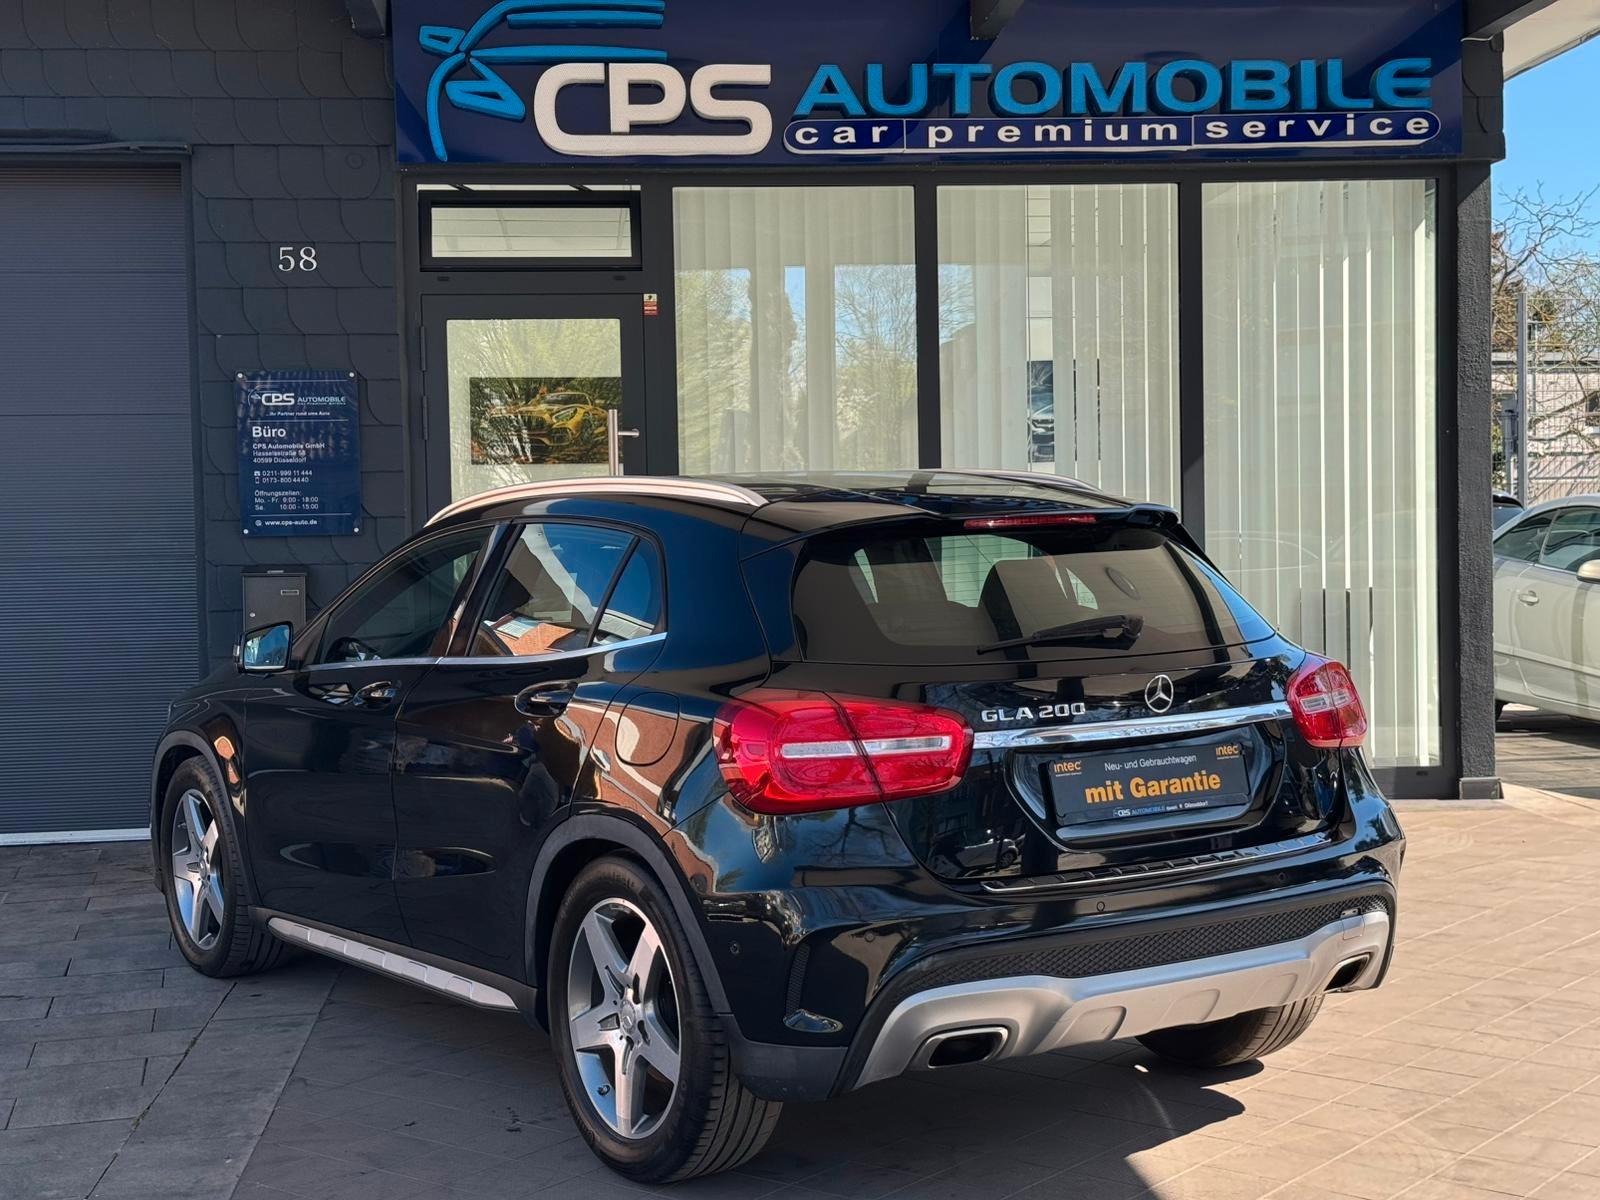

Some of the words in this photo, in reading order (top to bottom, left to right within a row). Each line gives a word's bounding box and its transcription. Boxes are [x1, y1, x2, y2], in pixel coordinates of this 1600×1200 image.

[534, 62, 772, 156] CPS
[793, 57, 1433, 118] AUTOMOBILE
[794, 124, 889, 145] car
[928, 119, 1178, 149] premium
[1206, 112, 1430, 140] service
[278, 246, 318, 271] 58
[261, 393, 295, 406] CPS
[252, 426, 287, 438] Büro
[981, 706, 1034, 724] GLA
[1038, 702, 1087, 719] 200
[1054, 760, 1082, 773] intec
[1104, 762, 1123, 772] Neu-
[1124, 759, 1138, 769] und
[1139, 754, 1198, 769] Gebrauchtwagen
[1085, 780, 1124, 804] mit
[1129, 769, 1222, 799] Garantie
